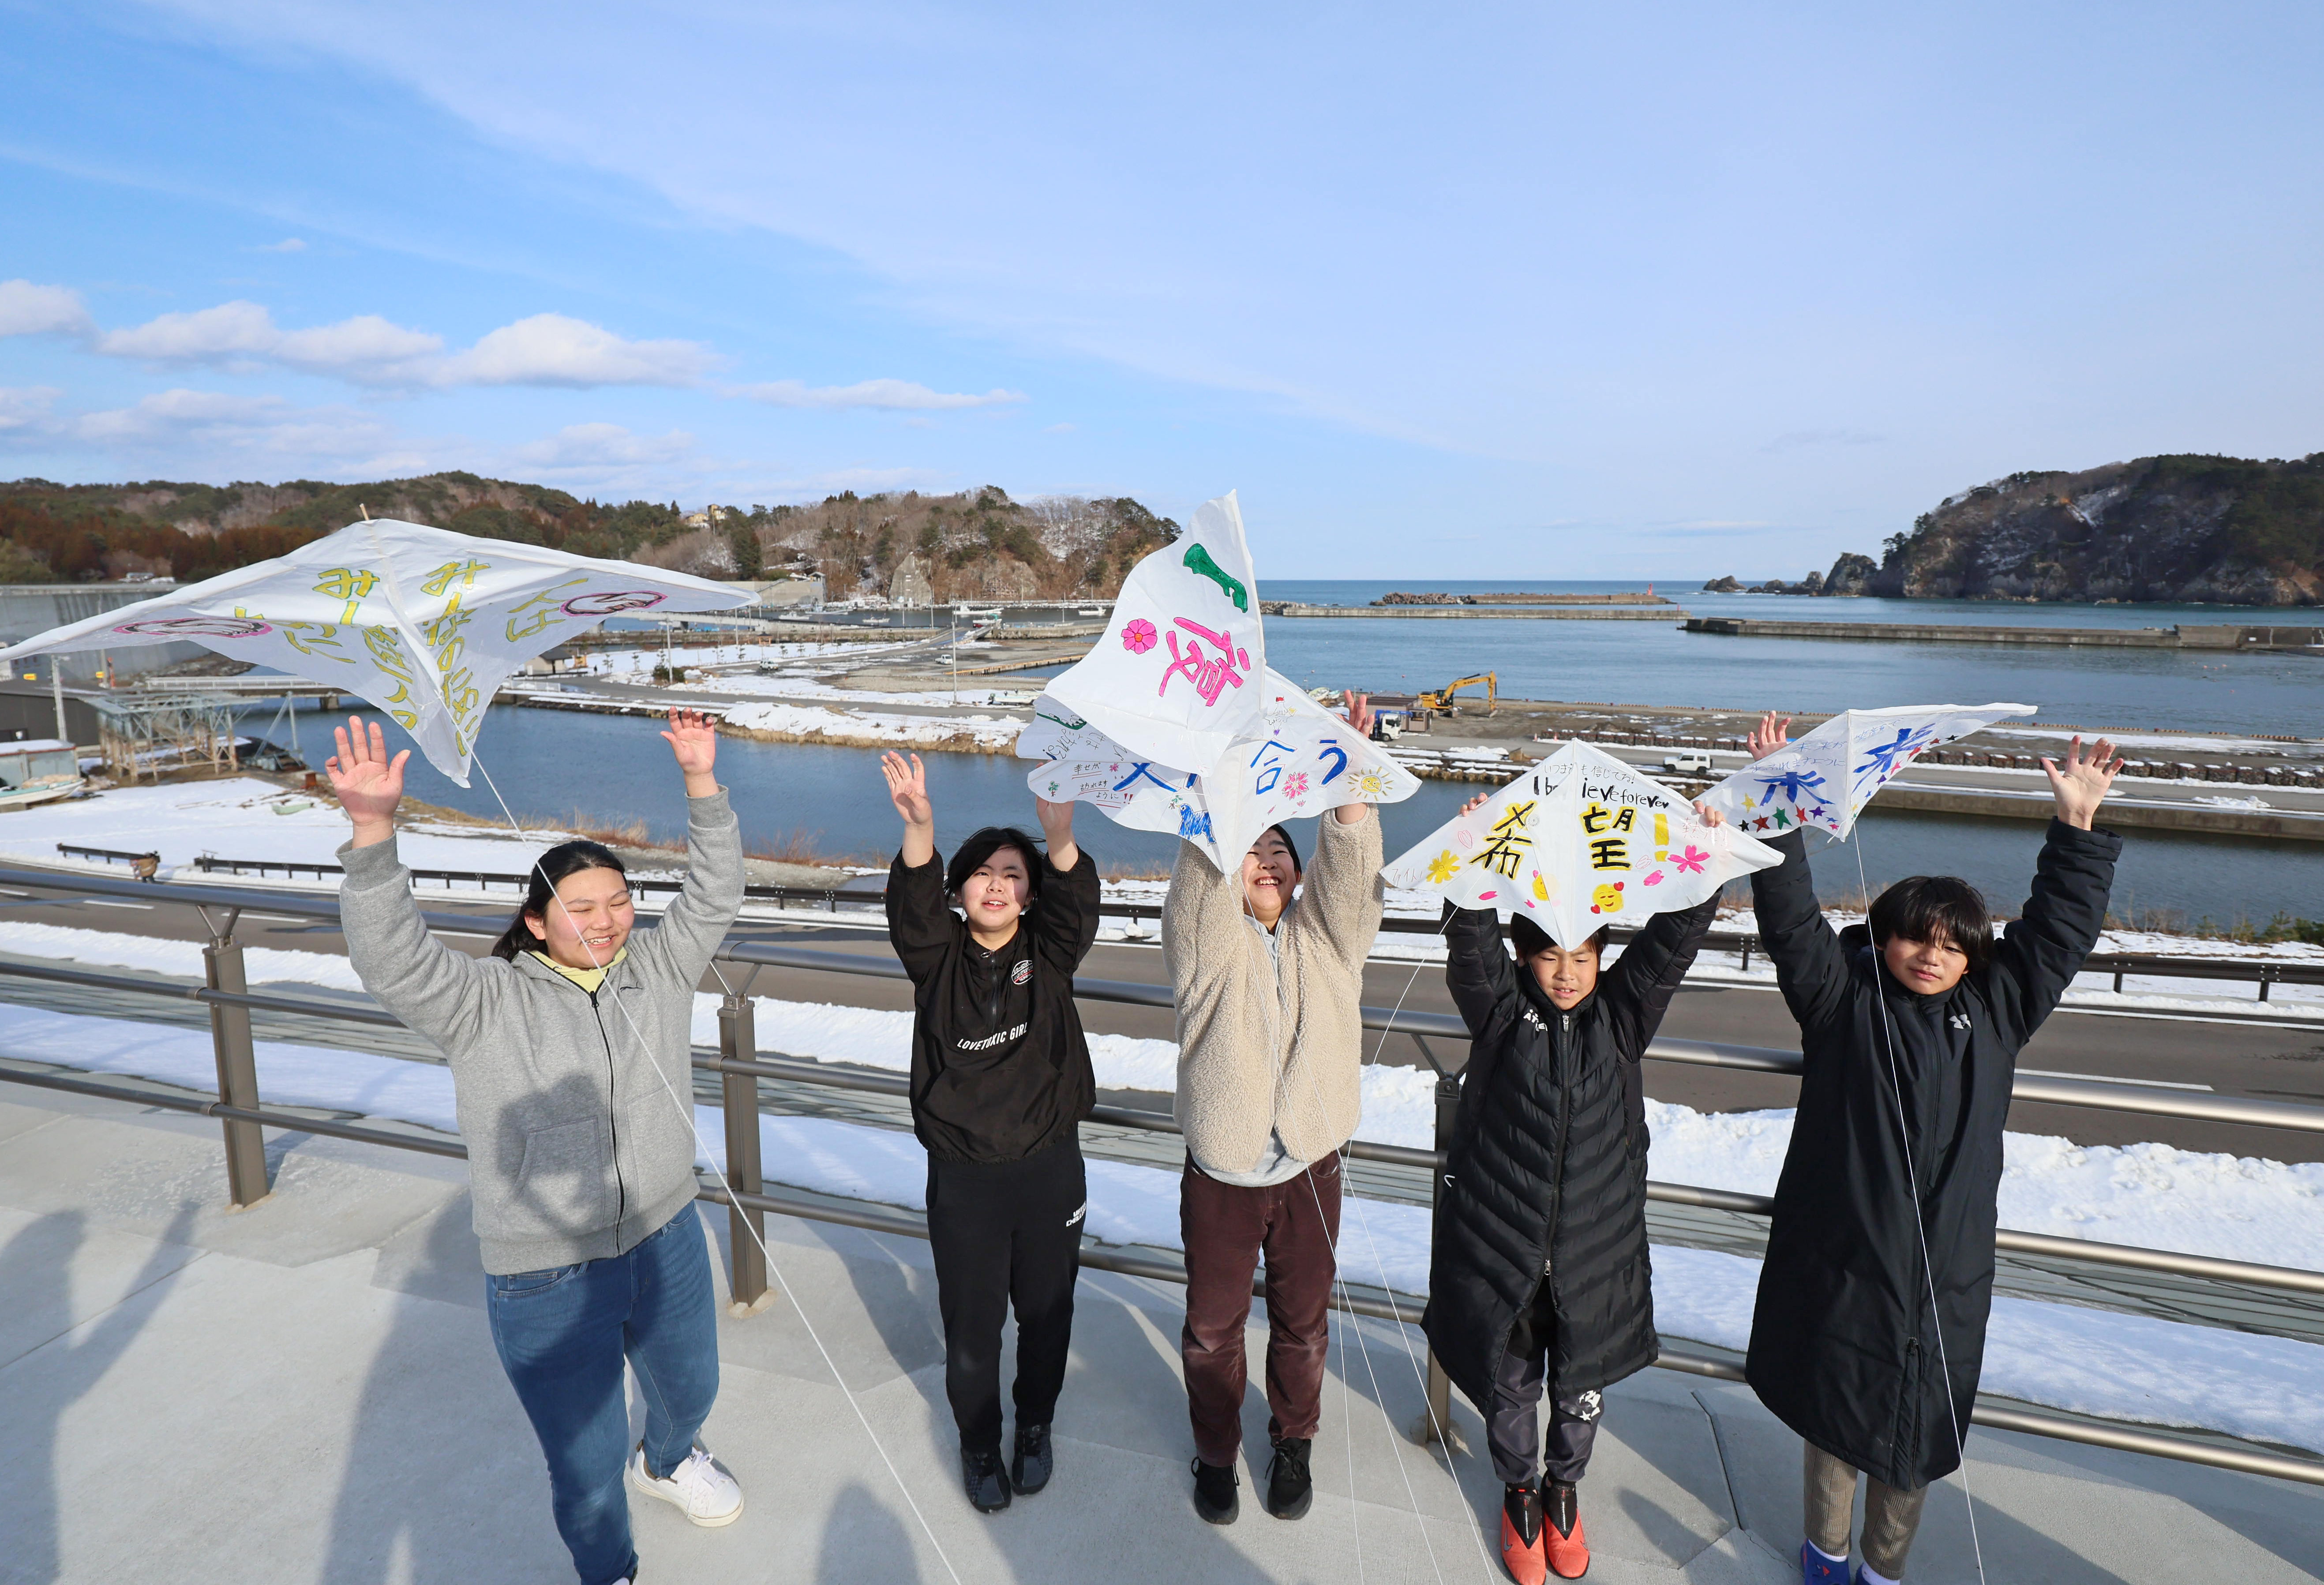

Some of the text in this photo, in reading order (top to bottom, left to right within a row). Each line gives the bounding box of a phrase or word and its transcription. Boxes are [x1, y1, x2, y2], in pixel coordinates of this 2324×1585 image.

[1073, 762, 1101, 775] 幸せが
[1080, 779, 1108, 791] 訪れます
[957, 1022, 1027, 1050] LOVETOXIC GIRL
